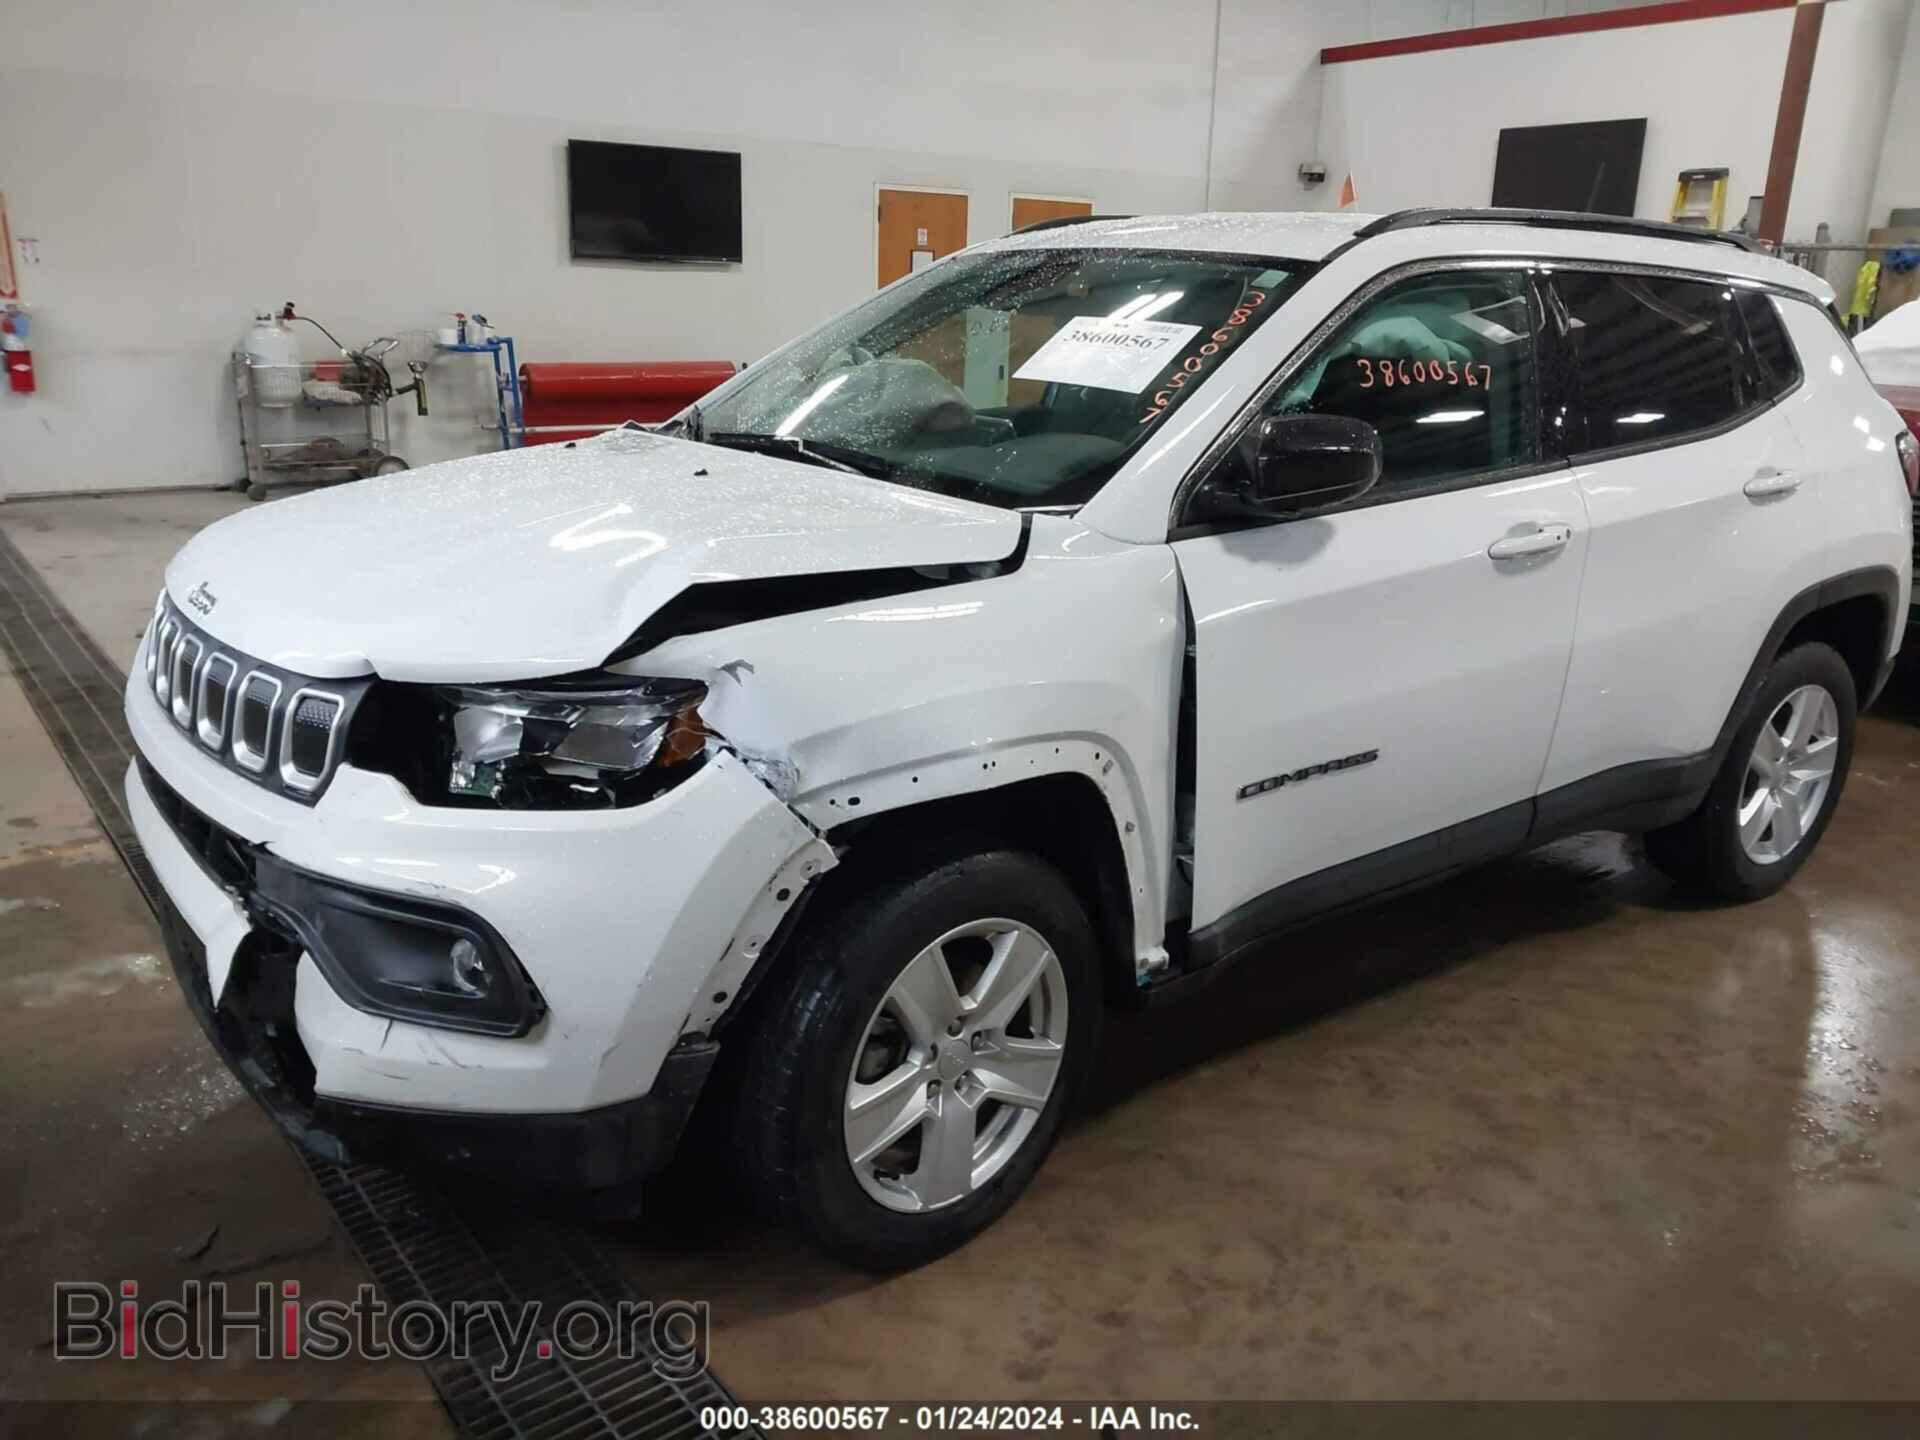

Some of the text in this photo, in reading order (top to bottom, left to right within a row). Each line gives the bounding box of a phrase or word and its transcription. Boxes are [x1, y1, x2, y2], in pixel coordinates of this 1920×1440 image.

[1063, 329, 1171, 350] 38600567
[1138, 290, 1266, 424] 38600567
[1356, 358, 1492, 391] 38600567
